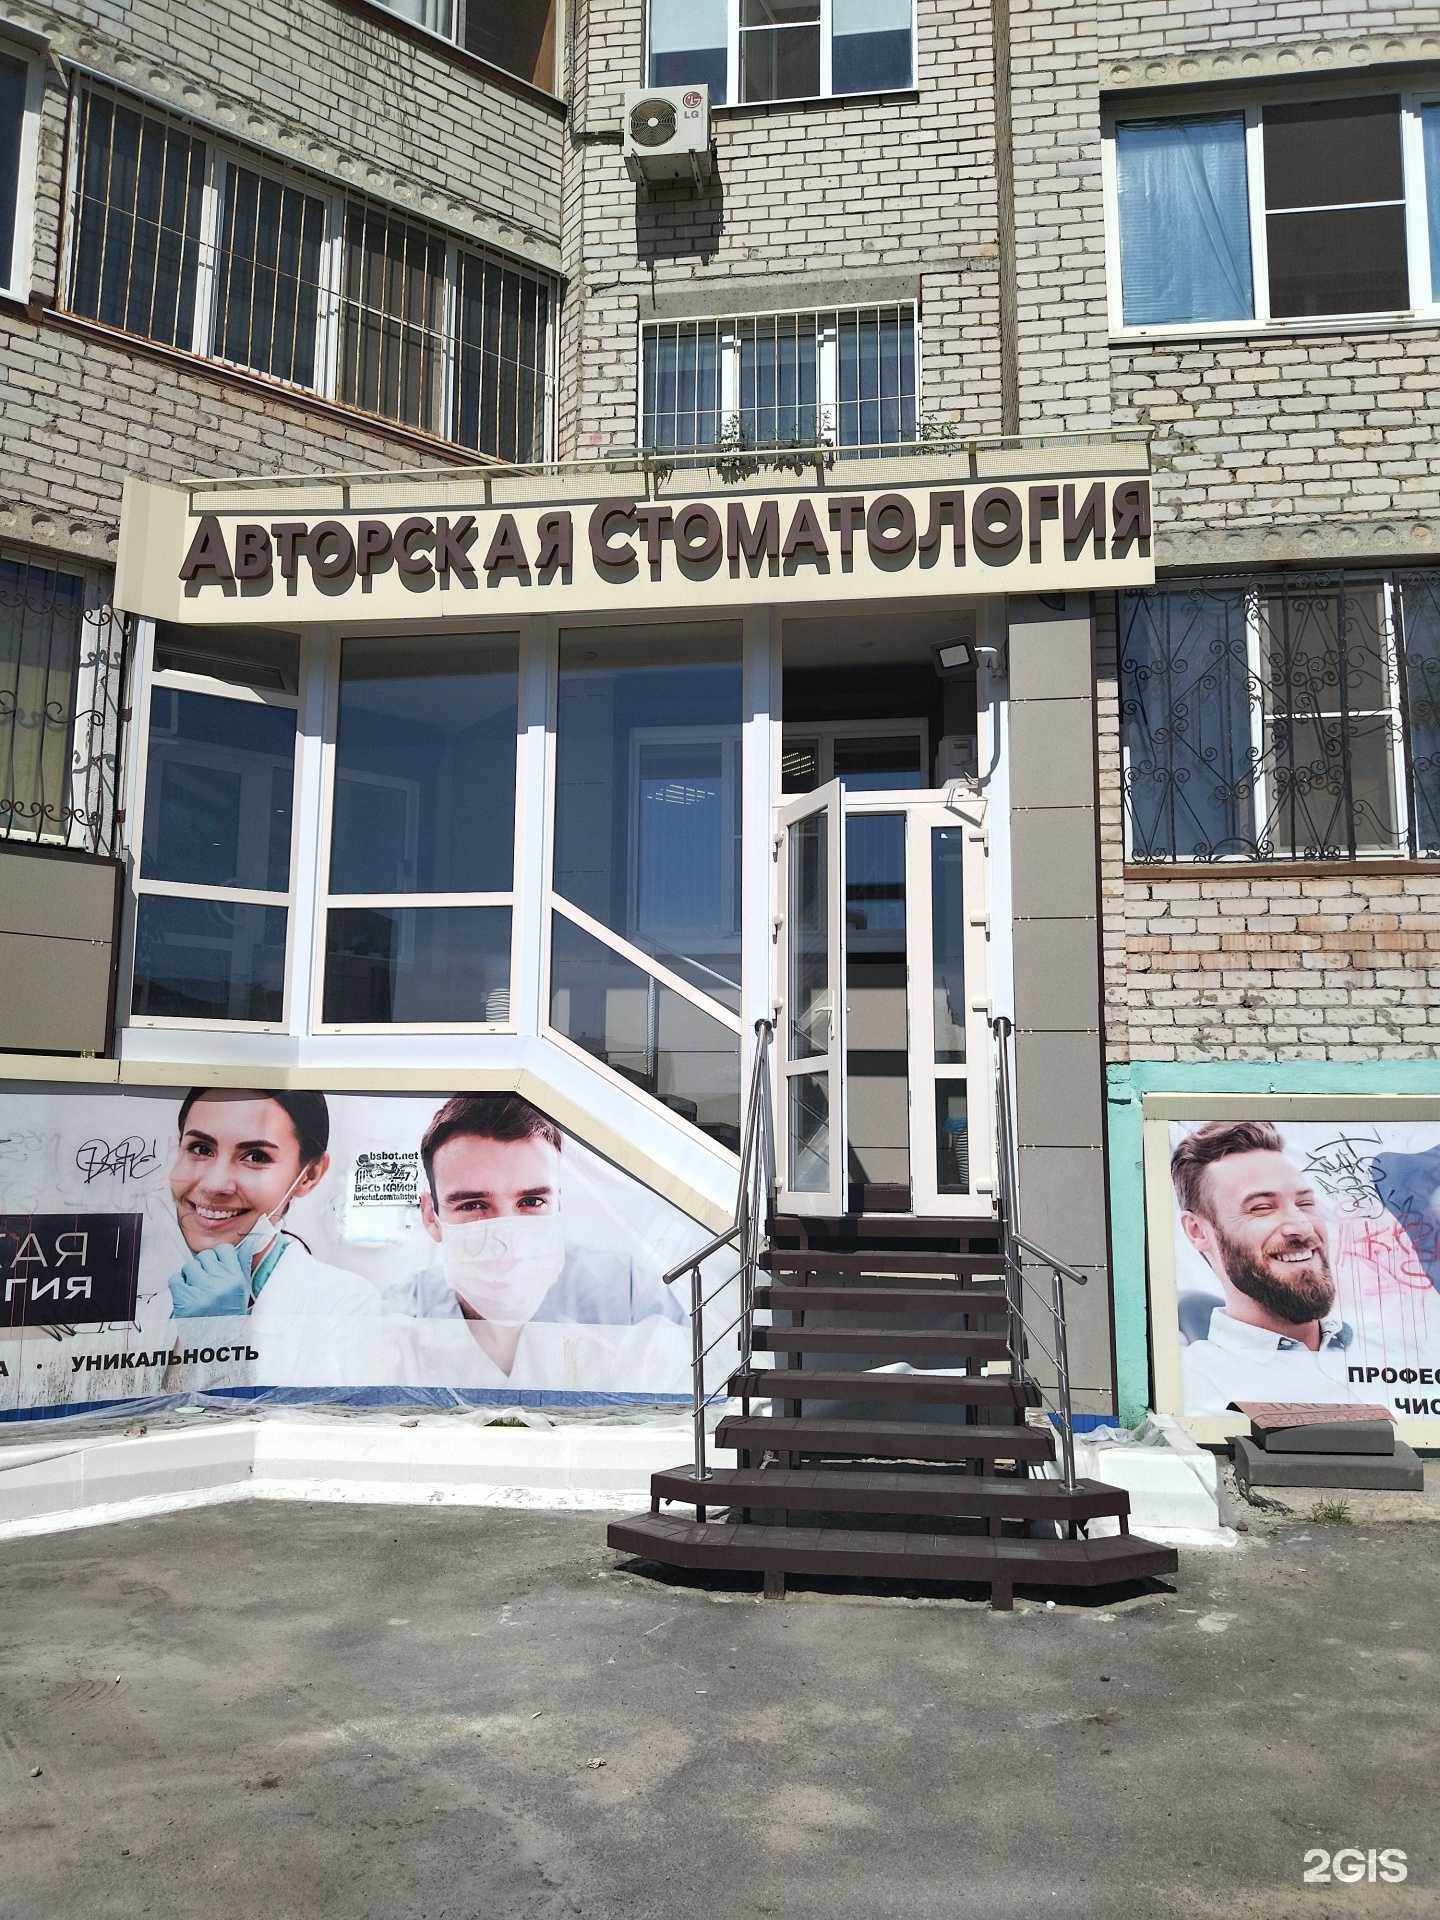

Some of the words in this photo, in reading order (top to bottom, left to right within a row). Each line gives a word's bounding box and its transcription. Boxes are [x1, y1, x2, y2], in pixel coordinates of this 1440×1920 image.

[684, 110, 699, 119] LG
[179, 509, 573, 581] АВТОРСКАЯ
[589, 479, 1152, 567] СТОМАТОЛОГИЯ
[369, 1151, 419, 1161] bsbot.net
[0, 1232, 89, 1268] АЯ
[71, 1345, 260, 1373] УНИКАЛЬНОСТЬ
